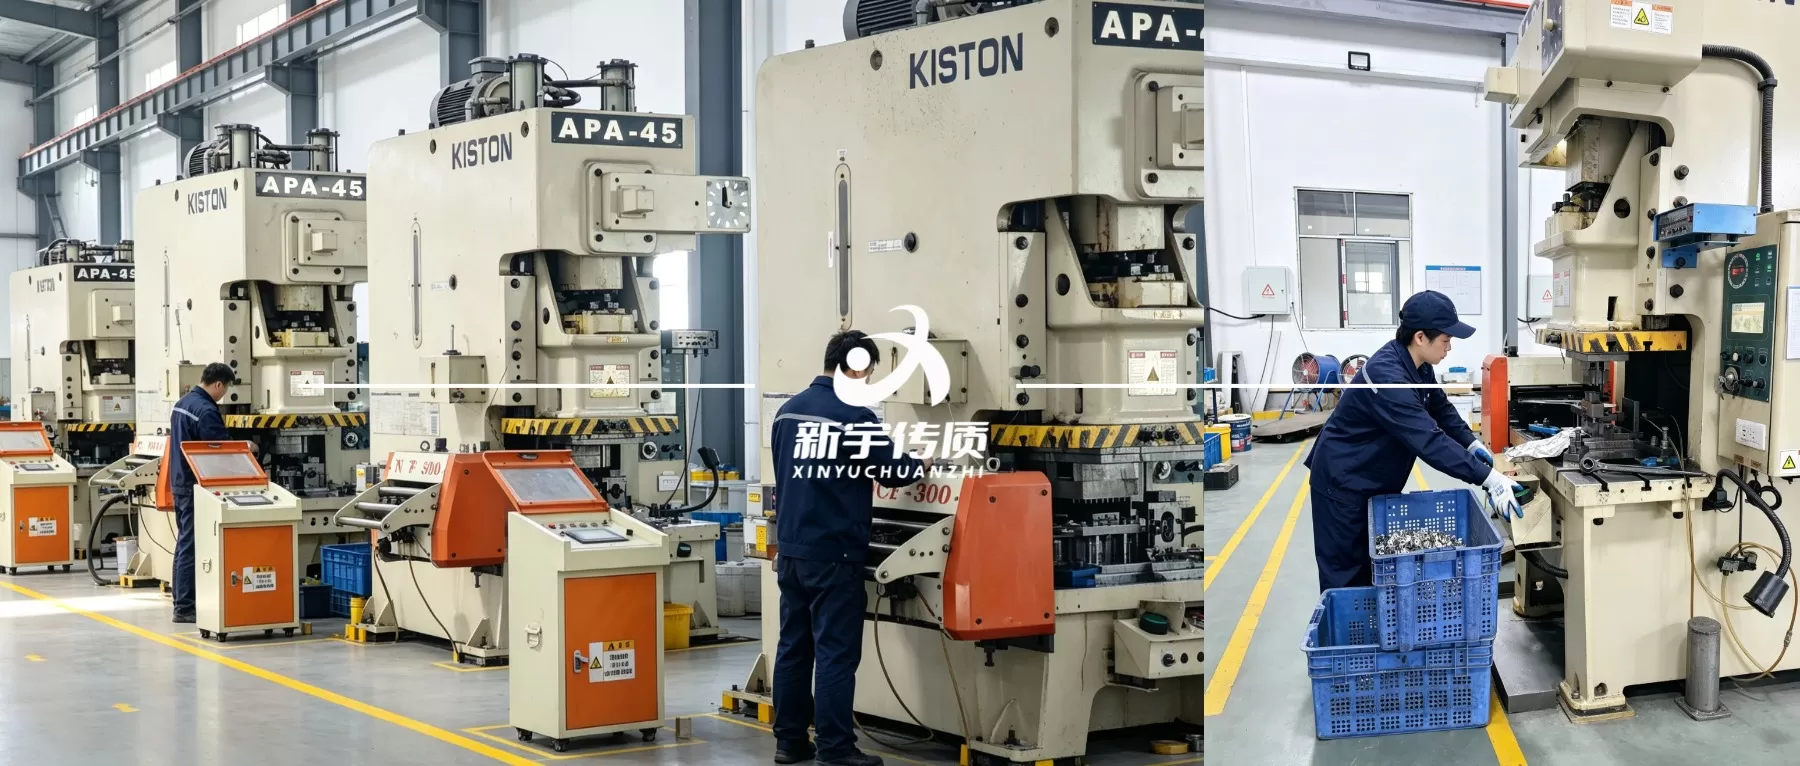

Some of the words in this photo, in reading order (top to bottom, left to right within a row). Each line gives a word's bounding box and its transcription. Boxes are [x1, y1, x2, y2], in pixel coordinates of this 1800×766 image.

[1100, 10, 1204, 43] APA-
[909, 32, 1024, 90] KISTON
[558, 117, 677, 144] APA-45
[451, 132, 513, 170] KISTON
[187, 187, 227, 215] KISTON
[262, 176, 363, 197] APA-45
